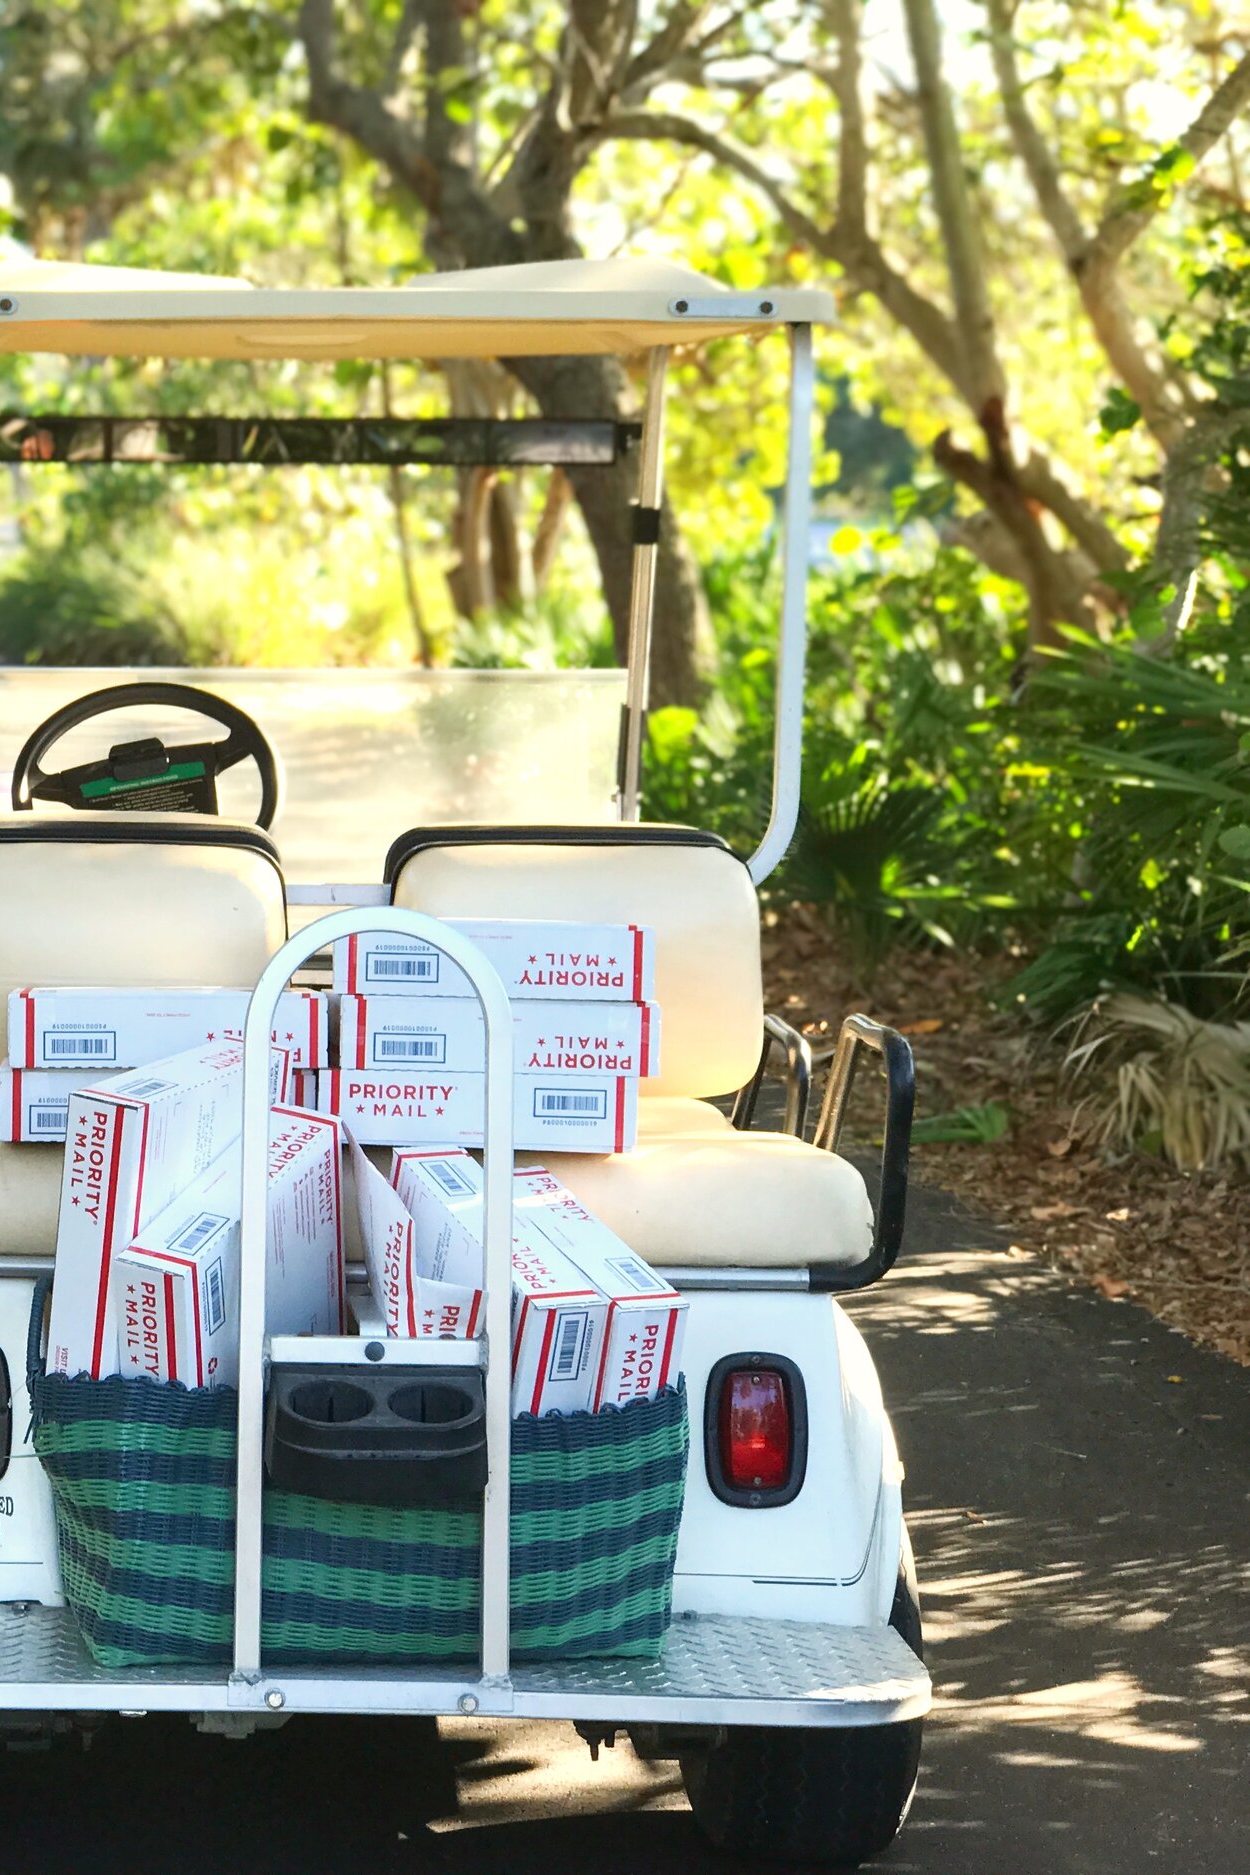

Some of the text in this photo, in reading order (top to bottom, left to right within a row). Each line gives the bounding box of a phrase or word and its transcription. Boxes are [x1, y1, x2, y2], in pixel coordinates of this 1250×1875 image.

[519, 969, 624, 987] PRIORITY
[546, 953, 600, 966] MAIL
[529, 1052, 632, 1070] PRIORITY
[555, 1036, 608, 1049] MAIL
[349, 1084, 454, 1100] PRIORITY
[374, 1104, 427, 1117] MAIL
[71, 1133, 88, 1188] MAIL
[84, 1111, 108, 1221] PRIORITY
[324, 1149, 333, 1223] PRIORITY
[537, 1177, 593, 1221] PRIORITY
[388, 1221, 403, 1337] PRIORITY
[520, 1246, 551, 1275] MAIL
[126, 1300, 139, 1347] MAIL
[140, 1281, 160, 1377] PRIORITY
[60, 1347, 69, 1367] VISIT
[617, 1350, 636, 1402] MAIL
[635, 1324, 659, 1398] PRIORI
